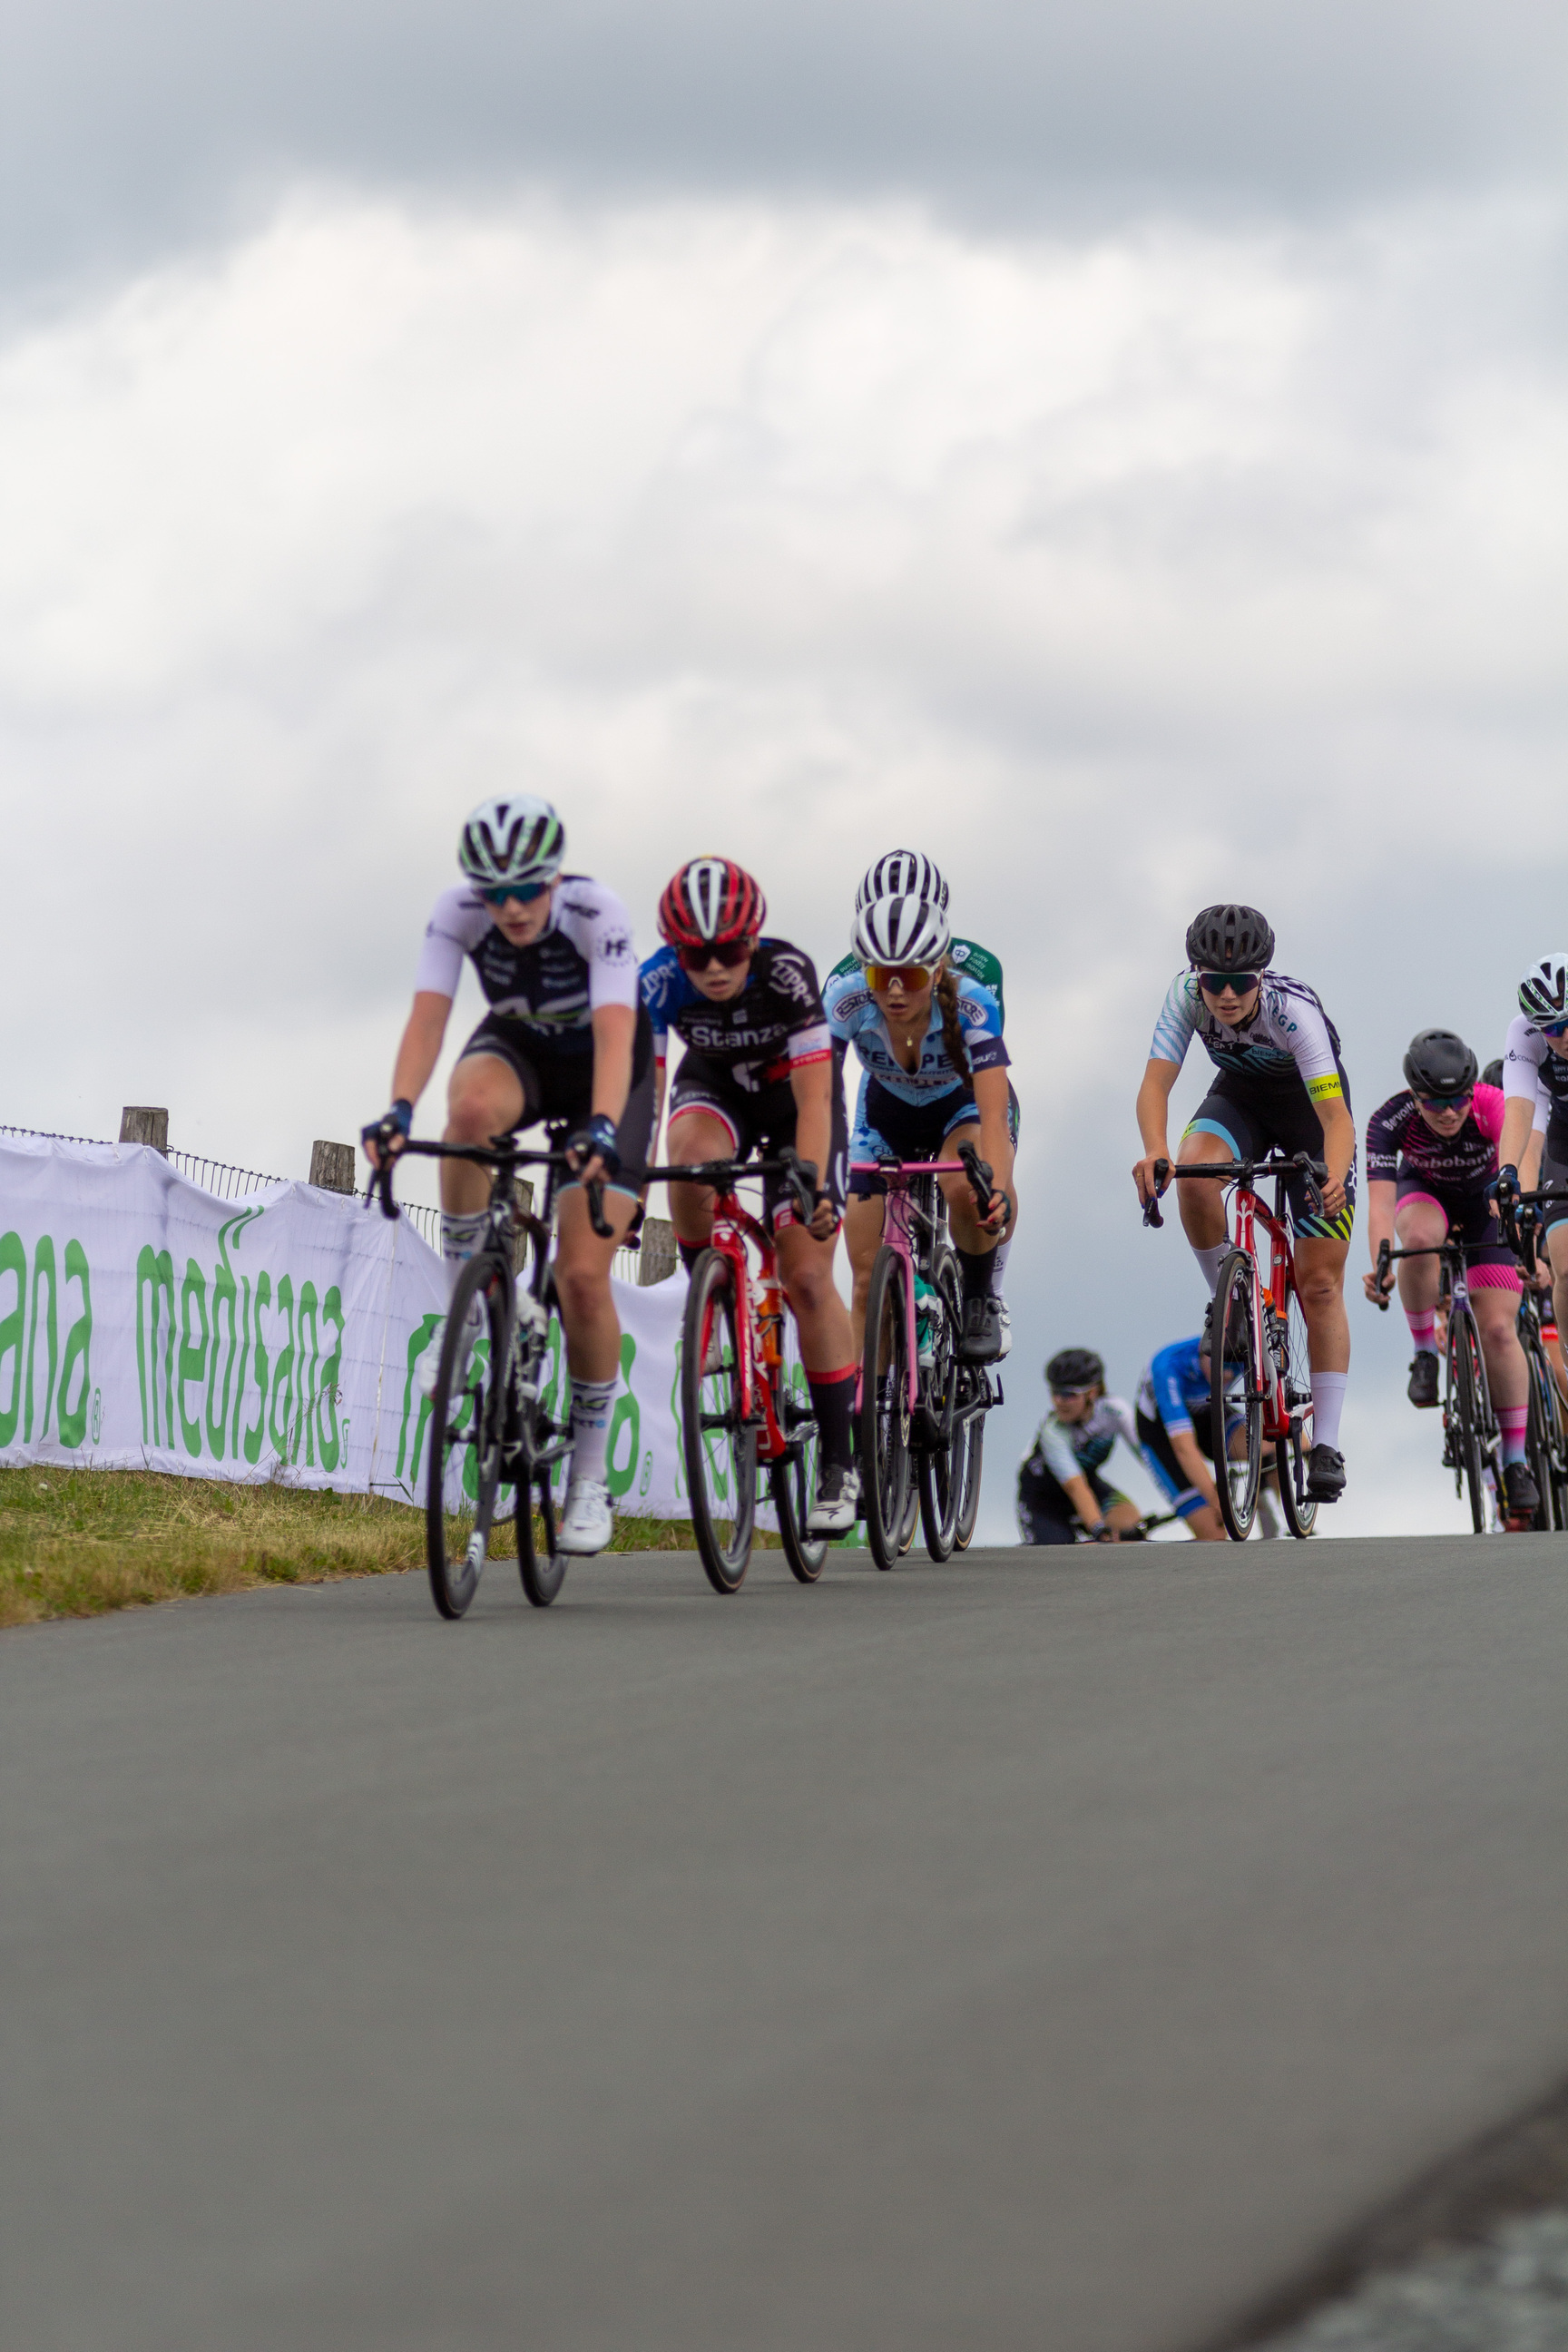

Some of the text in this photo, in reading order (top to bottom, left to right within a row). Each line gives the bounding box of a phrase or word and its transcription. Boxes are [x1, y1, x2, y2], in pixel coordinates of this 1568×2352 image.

[605, 939, 628, 956] HF
[1408, 1145, 1495, 1170] Rabobank
[137, 1206, 345, 1472] medisana
